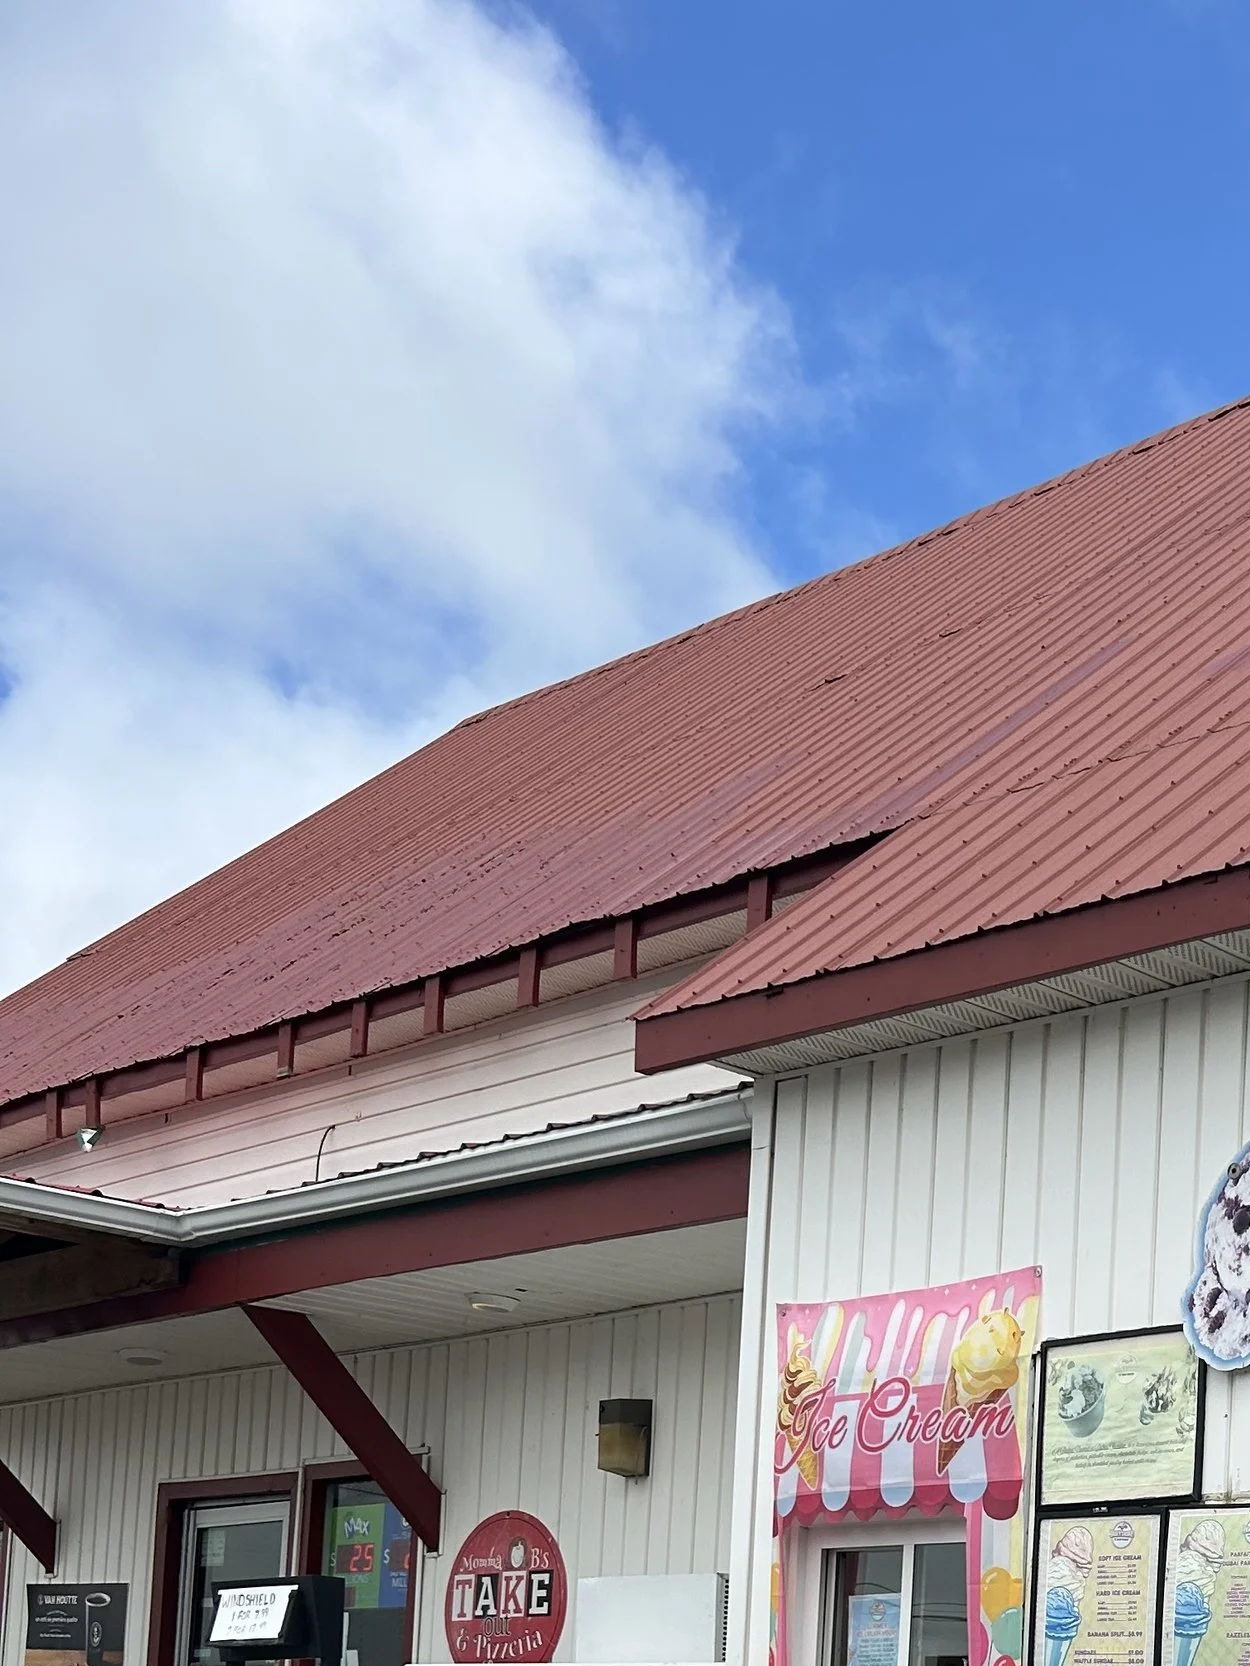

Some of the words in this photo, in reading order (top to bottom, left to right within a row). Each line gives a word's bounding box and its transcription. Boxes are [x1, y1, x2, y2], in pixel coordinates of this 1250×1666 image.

[773, 1378, 848, 1474] Ice
[857, 1376, 1015, 1452] Cream
[349, 1544, 374, 1572] 25
[460, 1546, 502, 1572] Momma
[529, 1548, 549, 1570] B's
[44, 1595, 56, 1604] VAN
[56, 1595, 78, 1605] HOUTTE
[222, 1592, 276, 1608] WINDSHIELD
[453, 1571, 552, 1621] TAKE
[483, 1613, 512, 1637] out
[473, 1630, 543, 1660] Pizzeria
